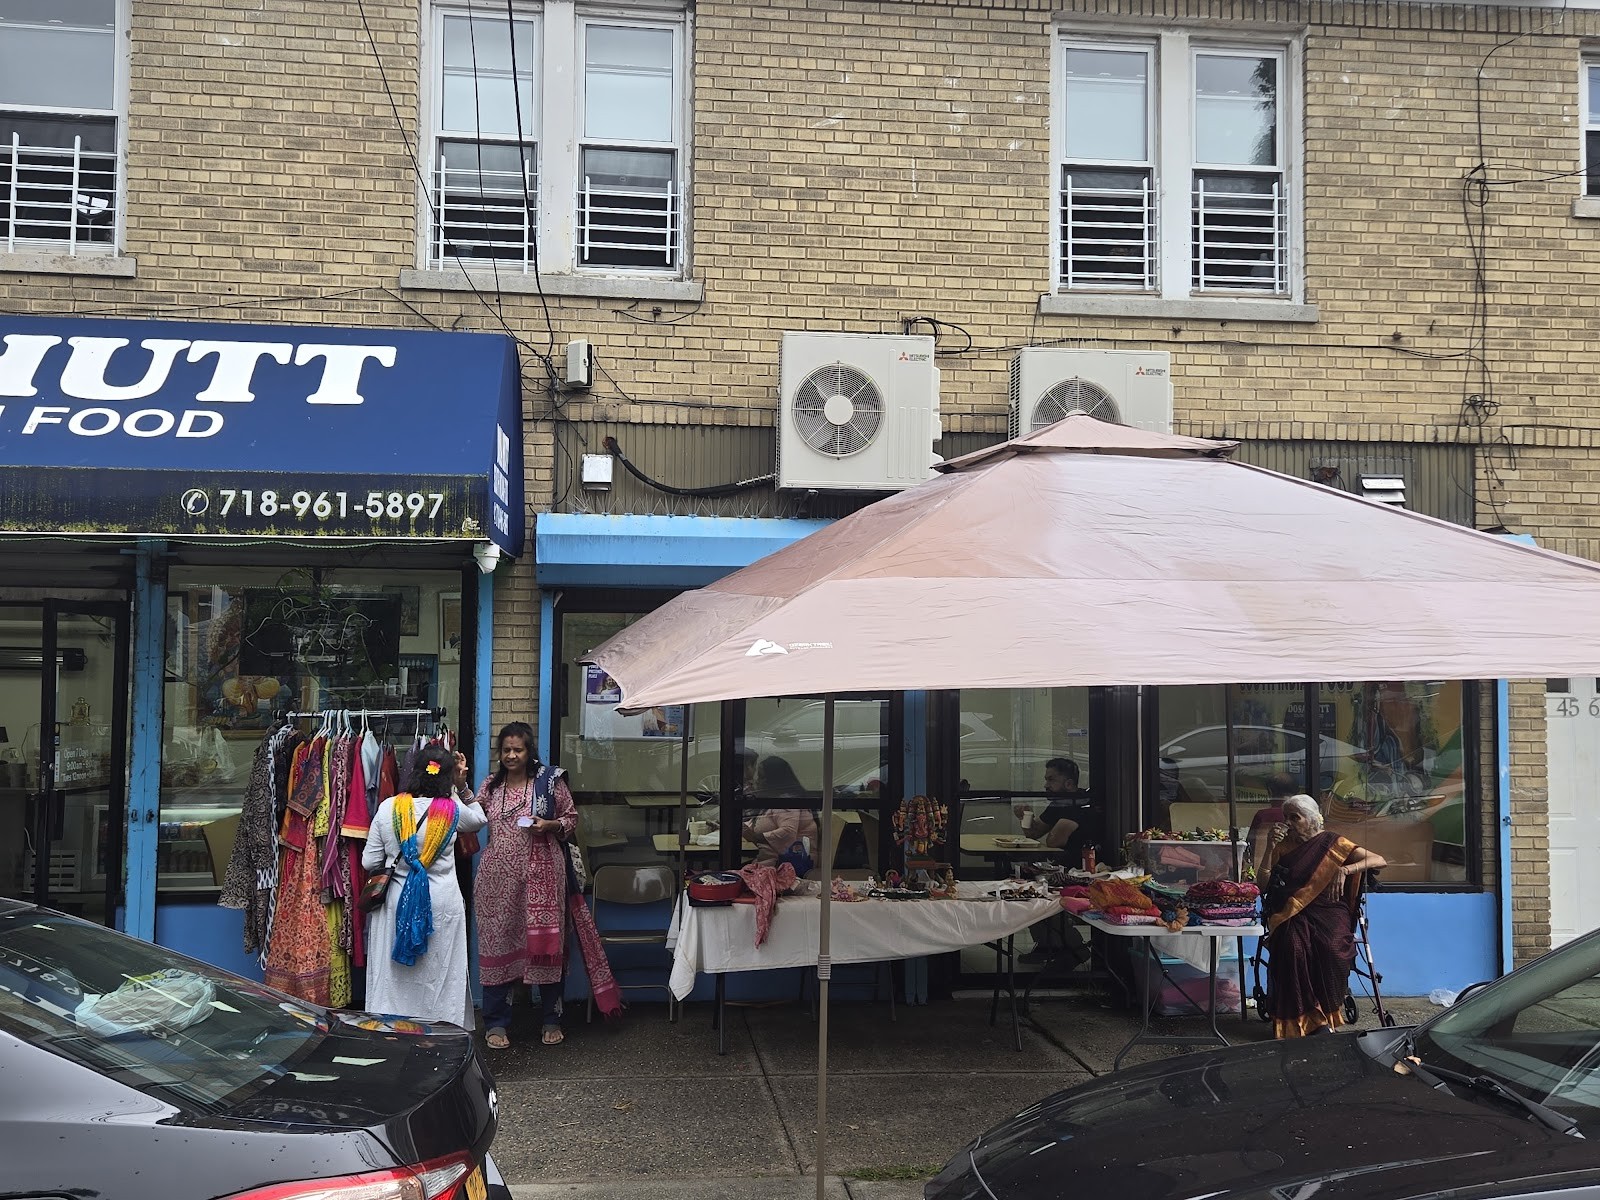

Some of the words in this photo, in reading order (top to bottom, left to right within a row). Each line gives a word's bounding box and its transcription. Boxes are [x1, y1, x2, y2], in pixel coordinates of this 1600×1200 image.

[21, 406, 225, 438] FOOD
[219, 489, 444, 518] 718-961-5897
[1556, 697, 1580, 717] 45
[63, 749, 75, 760] Open
